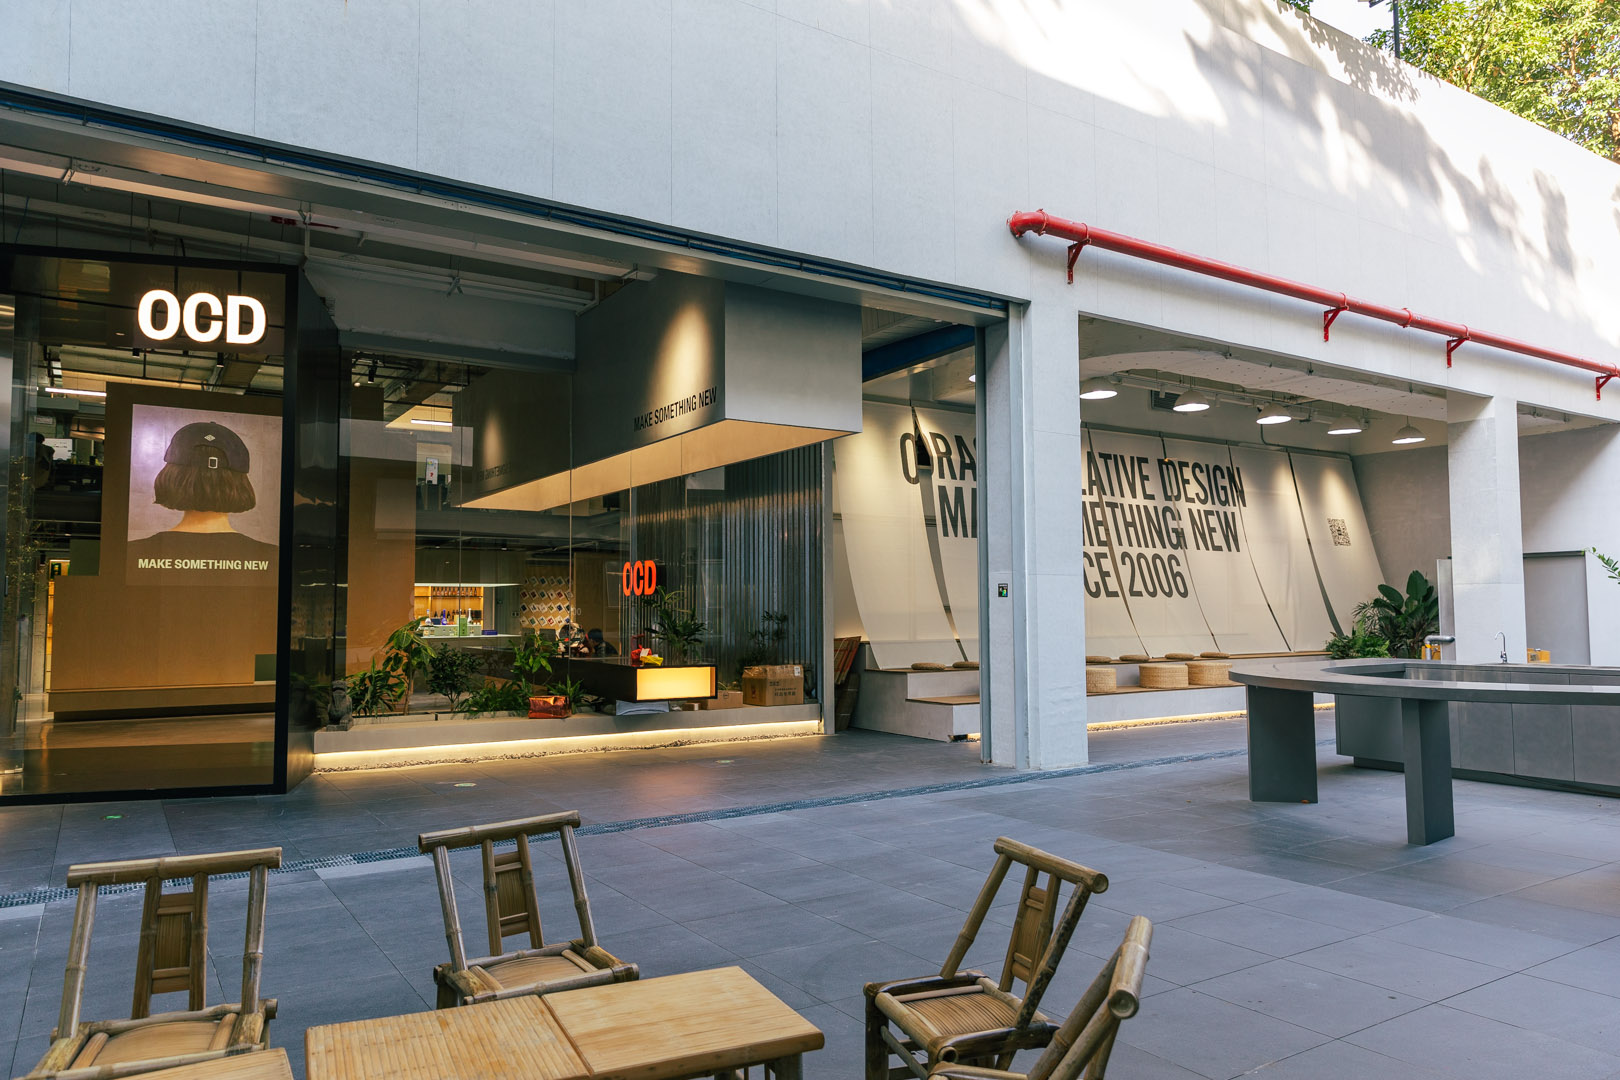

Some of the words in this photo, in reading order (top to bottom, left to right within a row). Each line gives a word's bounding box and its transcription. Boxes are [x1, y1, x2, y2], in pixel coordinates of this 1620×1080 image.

[138, 289, 267, 345] OCD
[634, 411, 653, 432] MAKE
[654, 395, 697, 425] SOMETHING
[698, 386, 717, 409] NEW
[1082, 450, 1156, 501] ATIVE
[1157, 458, 1247, 508] DESIGN
[1188, 507, 1241, 553] NEW
[138, 558, 173, 569] MAKE
[174, 558, 242, 570] SOMETHING
[244, 560, 269, 571] NEW
[622, 560, 657, 597] OCD
[1121, 551, 1189, 598] 2006
